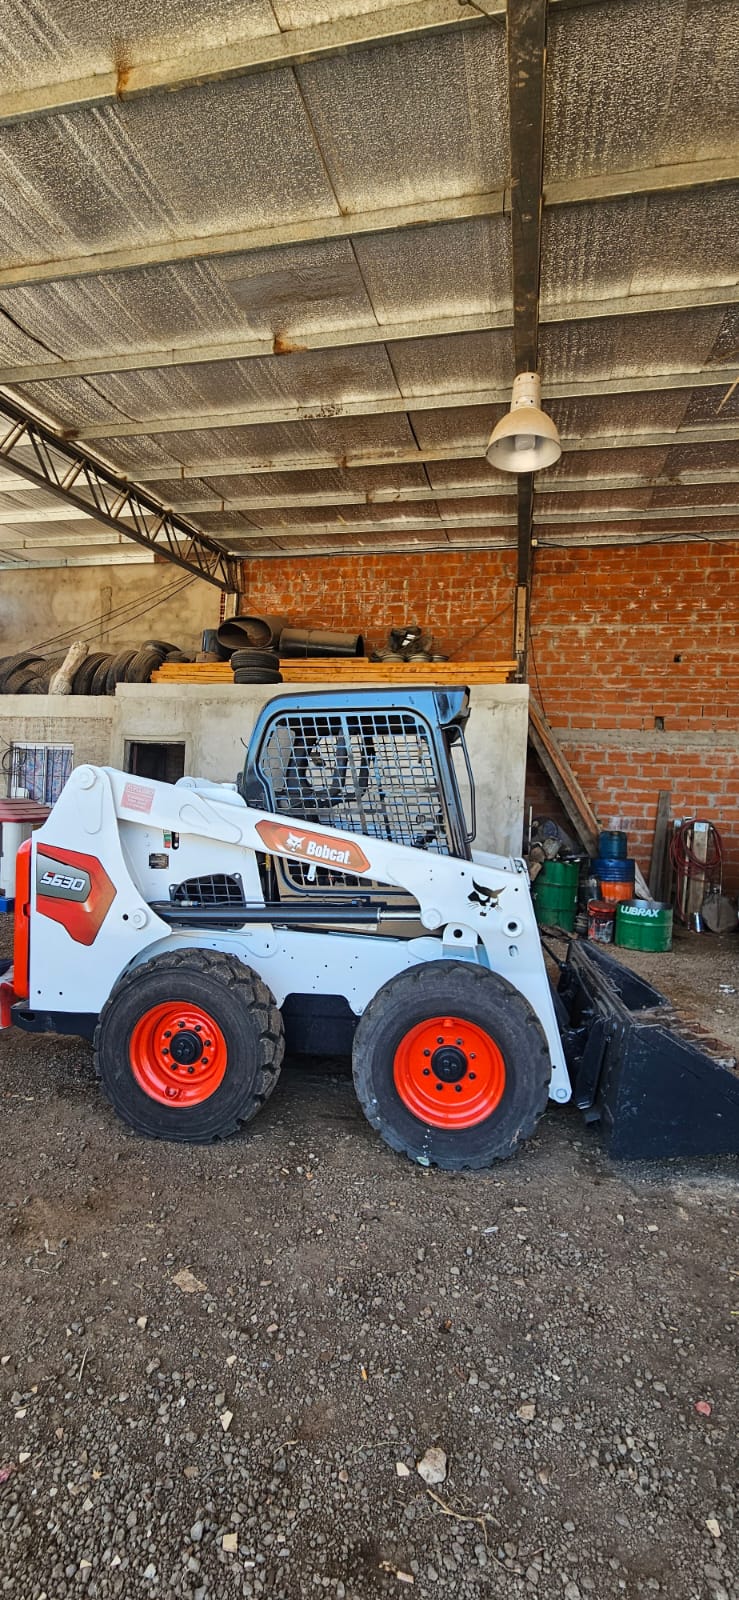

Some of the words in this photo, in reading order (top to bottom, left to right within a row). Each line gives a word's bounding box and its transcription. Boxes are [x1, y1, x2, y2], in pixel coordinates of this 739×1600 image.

[306, 840, 350, 865] Bobcat
[40, 871, 86, 891] S630
[620, 904, 660, 918] LUBRAX
